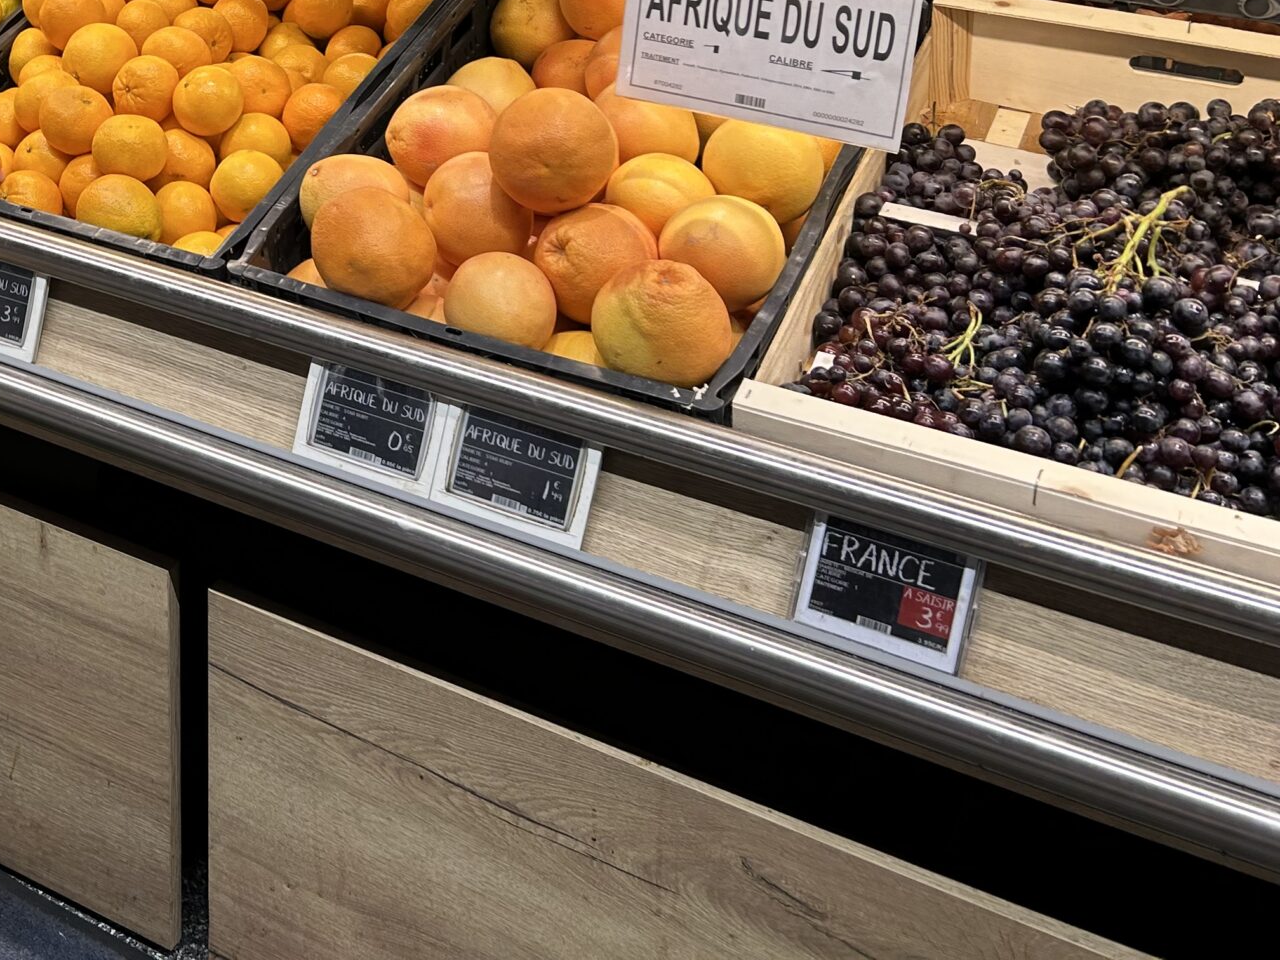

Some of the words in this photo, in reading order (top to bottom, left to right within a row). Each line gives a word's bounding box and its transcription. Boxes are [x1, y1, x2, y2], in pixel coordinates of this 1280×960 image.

[643, 31, 695, 48] CATEGORIE
[832, 5, 896, 62] SUD
[641, 51, 681, 65] TRAITEMENT
[769, 54, 814, 71] CALIBRE
[10, 282, 28, 297] SUD
[0, 305, 11, 322] 3
[325, 381, 377, 409] AFRIQUE
[382, 397, 398, 414] DU
[400, 404, 425, 423] SUD
[388, 431, 402, 451] 0
[465, 425, 522, 455] AFRIQUE
[528, 443, 546, 460] DU
[548, 451, 574, 470] SUD
[542, 480, 550, 500] 1
[822, 531, 936, 590] FRANCE
[904, 589, 912, 599] A
[915, 591, 955, 611] SAISIR
[916, 608, 933, 628] 3
[935, 623, 949, 634] 99
